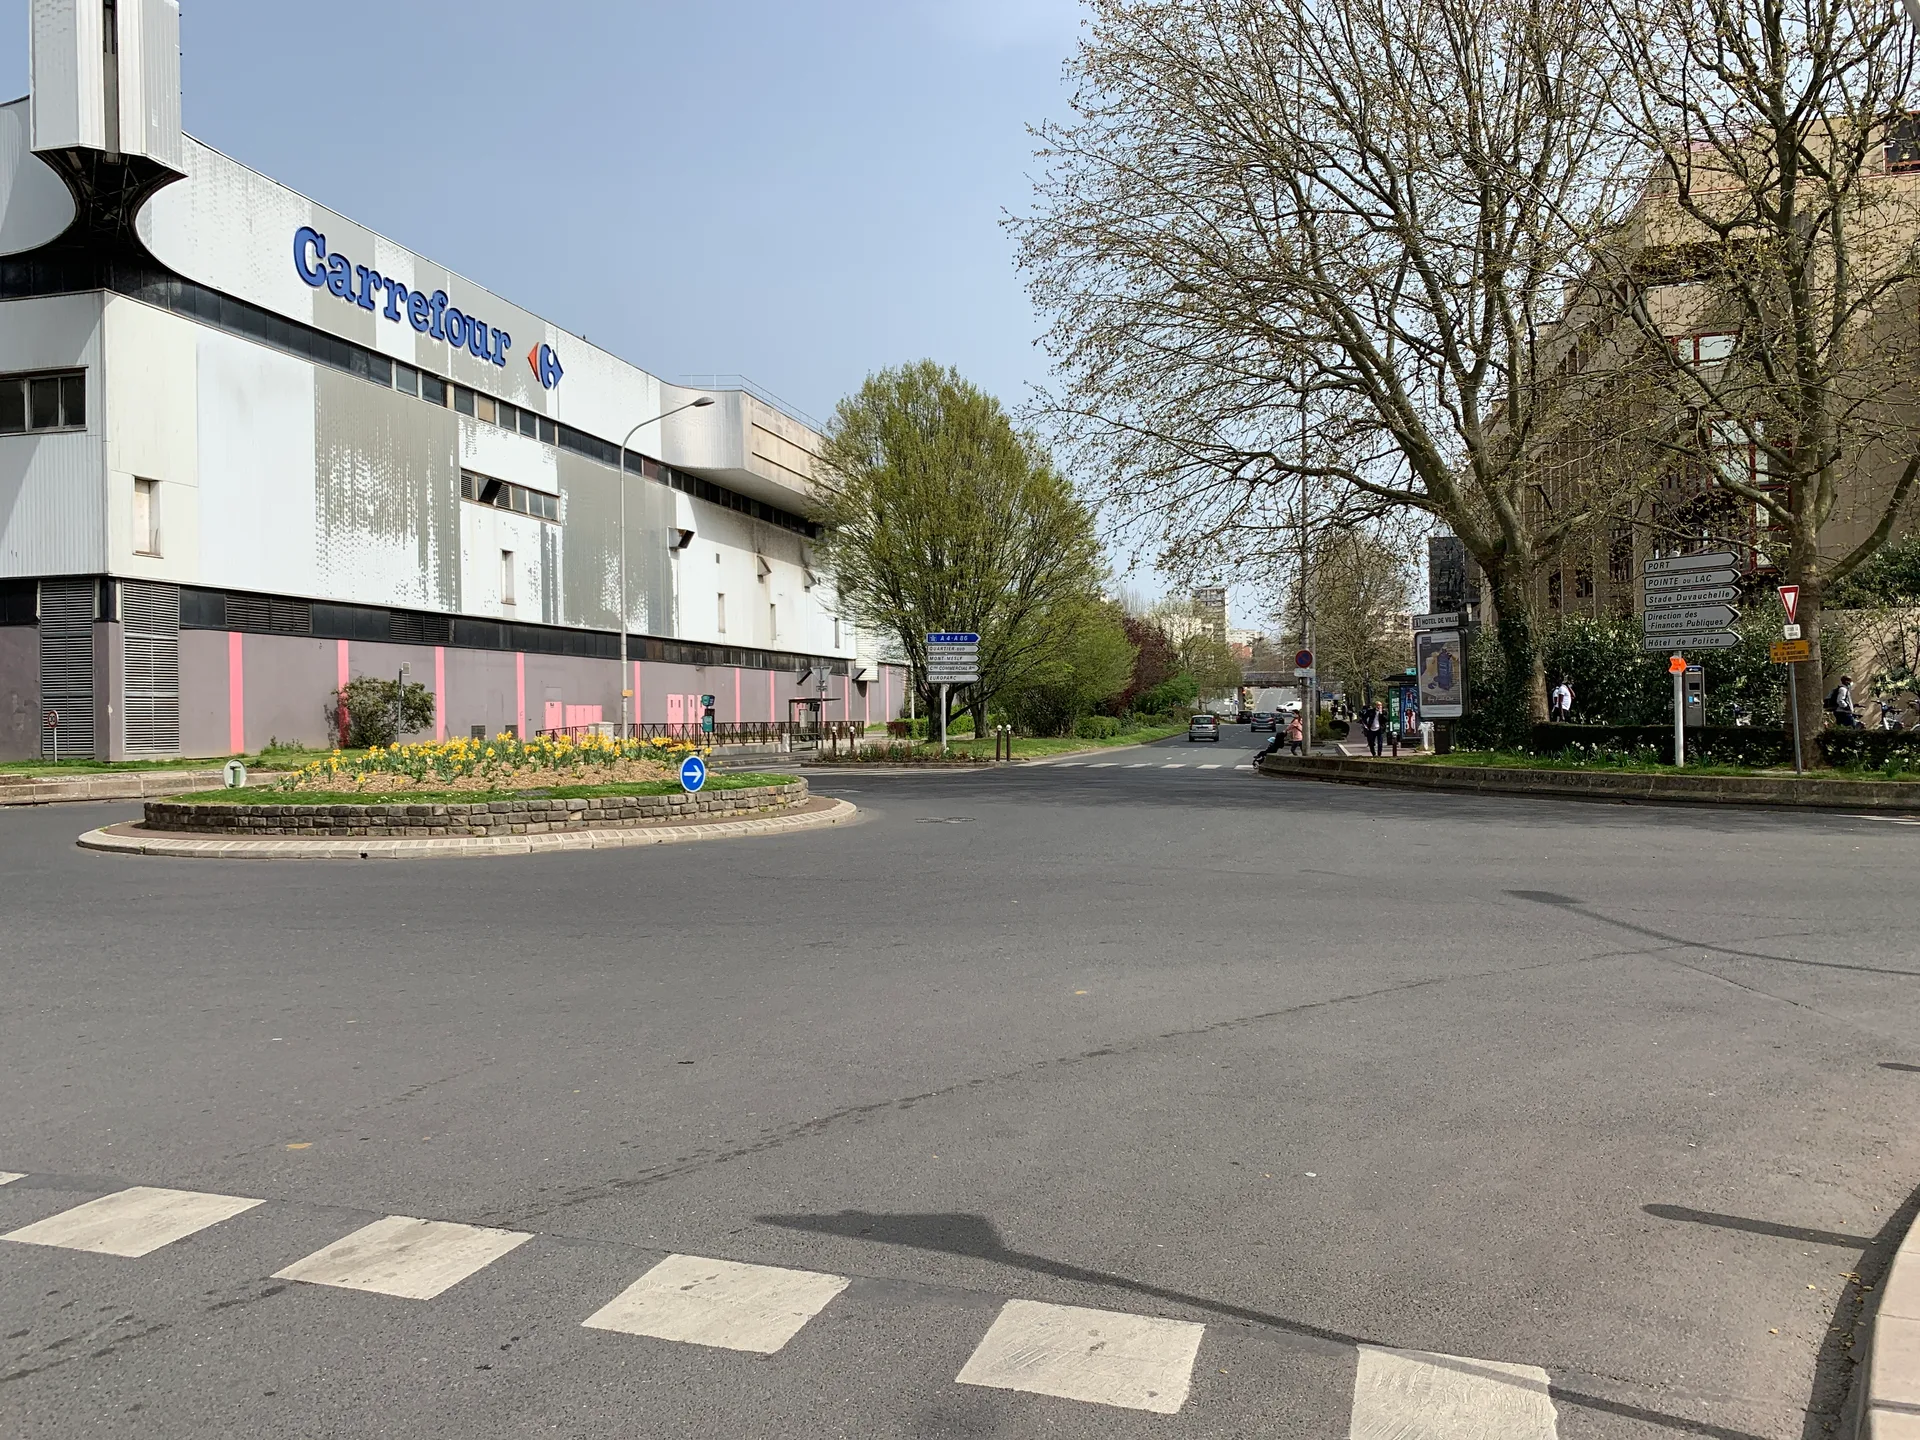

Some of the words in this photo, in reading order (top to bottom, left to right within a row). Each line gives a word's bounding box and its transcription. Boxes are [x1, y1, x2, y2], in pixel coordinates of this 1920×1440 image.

[293, 225, 512, 368] Carrefour
[1647, 561, 1670, 571] PORT
[1648, 577, 1679, 587] POINTE
[1695, 574, 1712, 583] LAC
[1648, 595, 1672, 604] Stade
[1676, 591, 1730, 601] Duvauchelle
[1437, 616, 1445, 624] DE
[1445, 615, 1459, 623] VILLE
[1647, 612, 1682, 621] Direction
[1684, 611, 1698, 619] des
[1650, 621, 1683, 630] Finances
[1686, 619, 1724, 628] Publiques
[1648, 638, 1671, 647] Hôtel
[1676, 638, 1686, 646] de
[1691, 637, 1720, 645] Police
